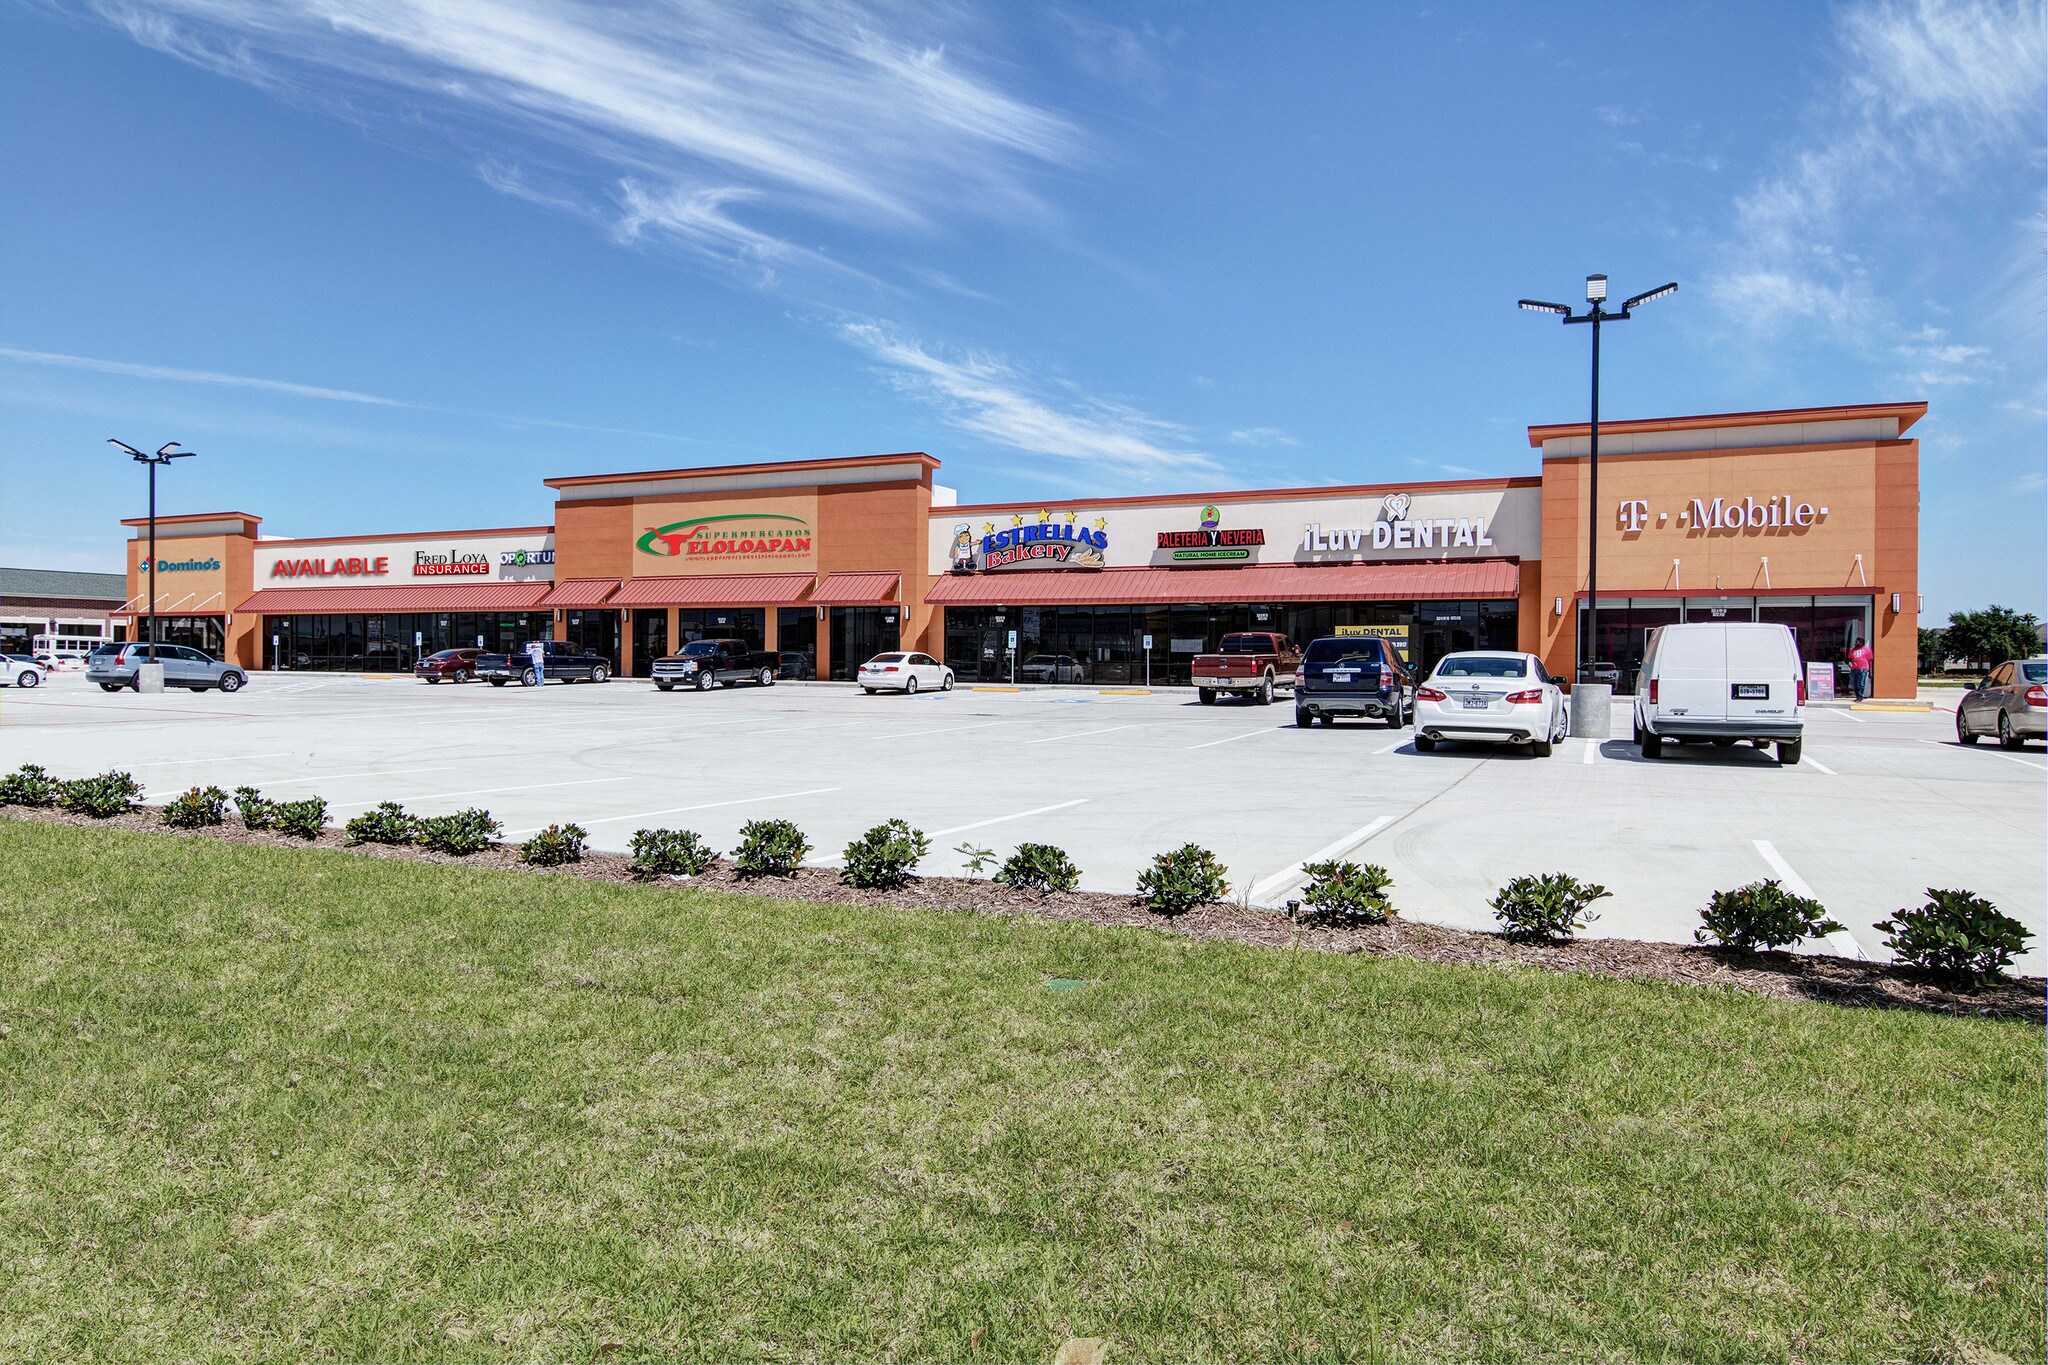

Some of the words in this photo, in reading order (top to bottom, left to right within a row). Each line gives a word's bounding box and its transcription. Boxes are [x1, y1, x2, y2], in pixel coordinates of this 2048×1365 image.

[696, 529, 811, 539] SUPERMERCADOS
[983, 524, 1108, 553] ESTRELLAS
[1158, 531, 1208, 547] PALETERIA
[1211, 531, 1217, 546] Y
[1220, 530, 1263, 545] NEVERIA
[1304, 523, 1362, 551] iLuv
[1373, 517, 1492, 549] DENTAL
[157, 557, 221, 572] Domino's
[987, 544, 1071, 569] Bakery
[273, 557, 389, 576] AVAILABLE
[416, 564, 487, 574] INSURANCE
[1363, 628, 1402, 636] DENTAL
